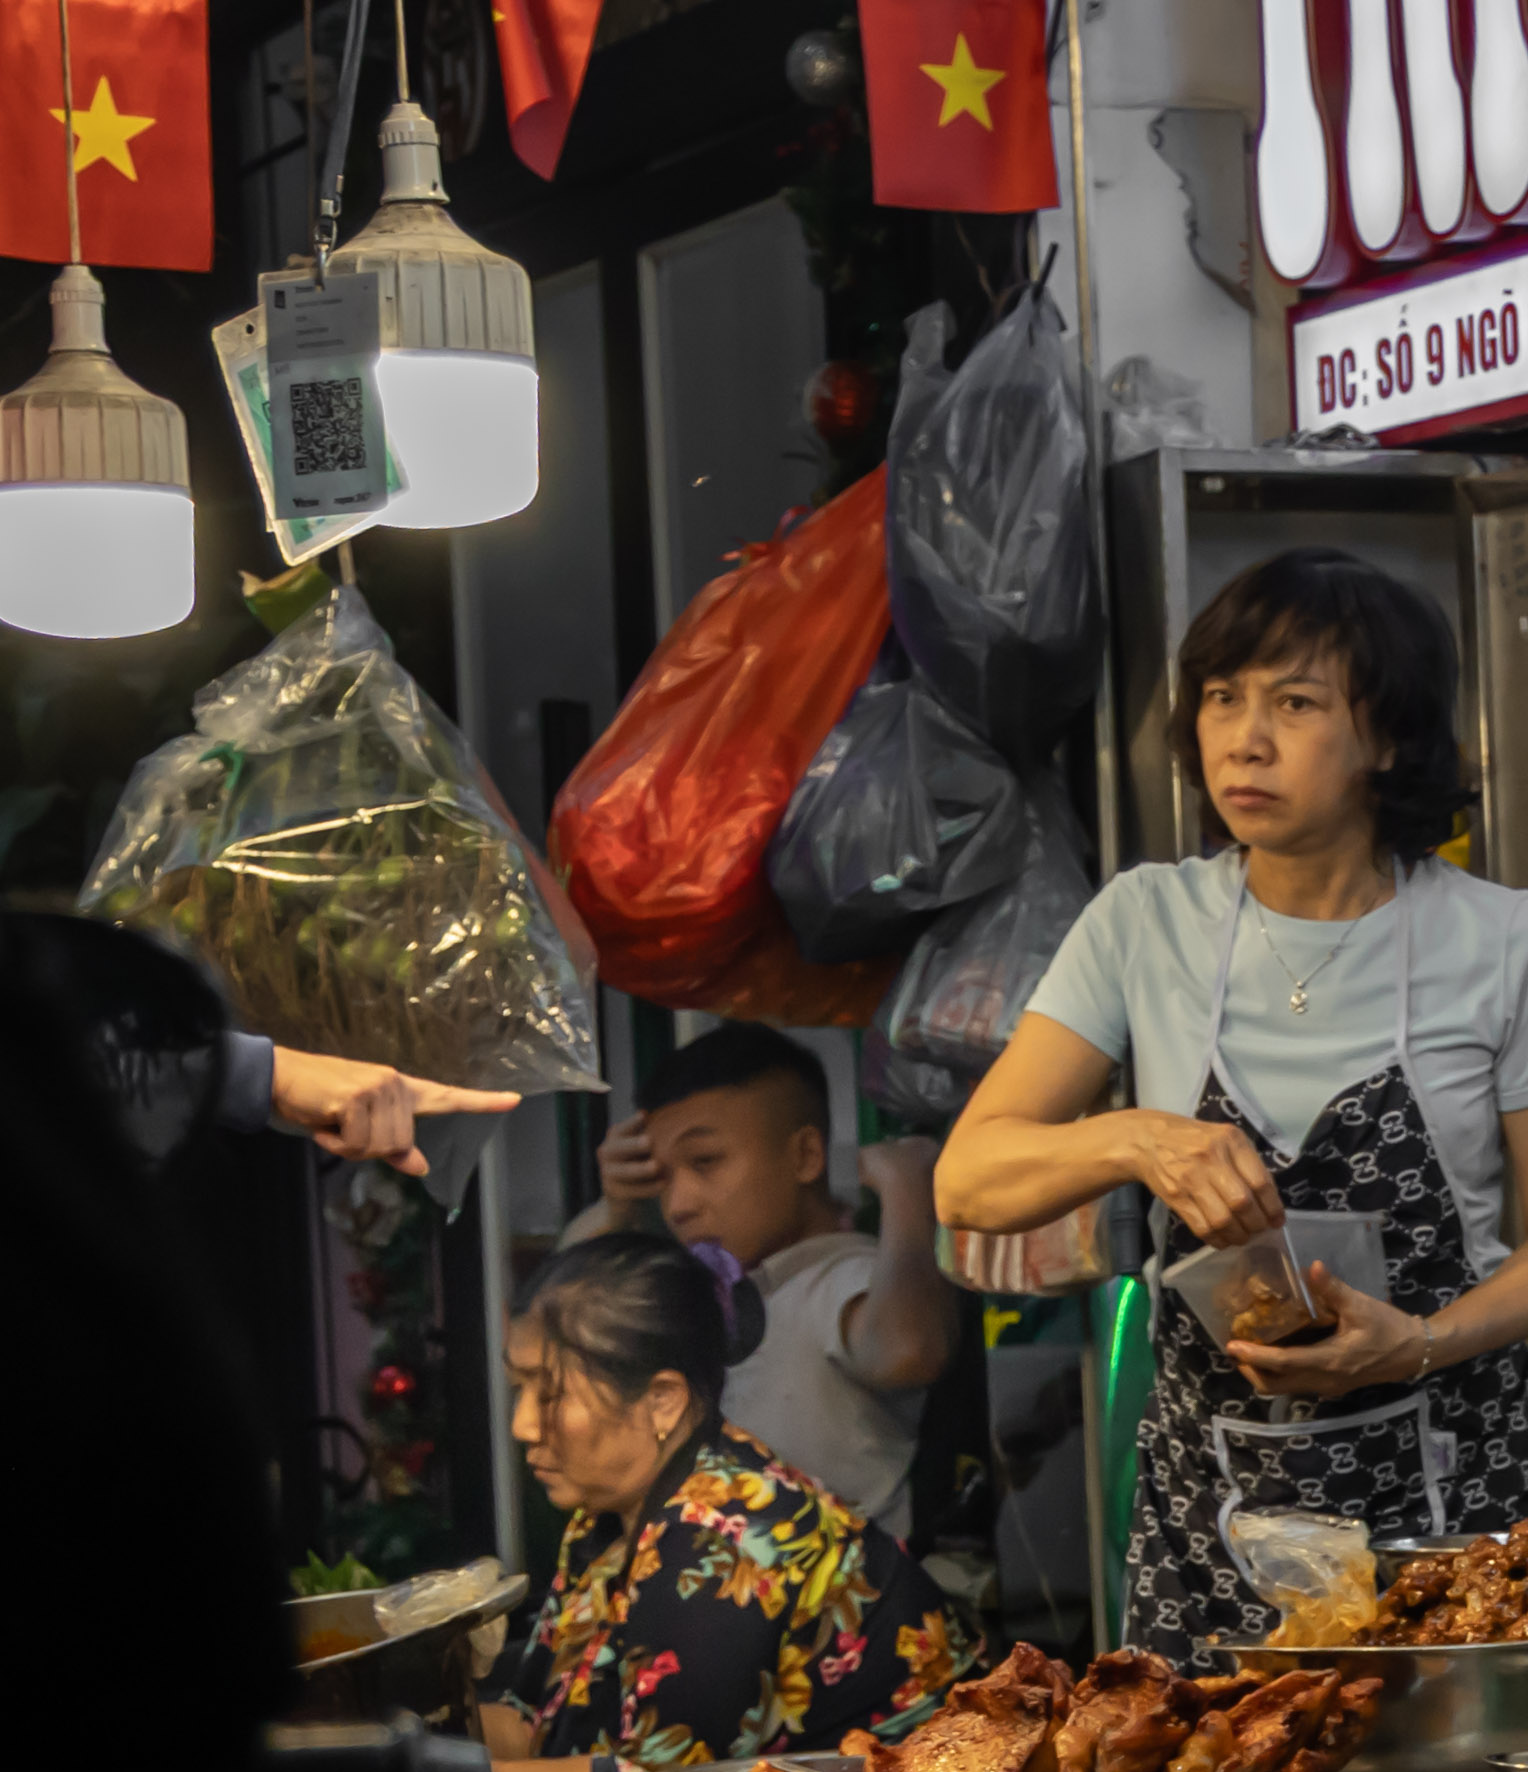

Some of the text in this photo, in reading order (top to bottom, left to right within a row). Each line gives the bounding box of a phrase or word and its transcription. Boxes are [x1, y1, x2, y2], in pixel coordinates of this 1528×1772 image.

[1317, 348, 1367, 414] ĐC:
[1376, 304, 1414, 399] SỐ
[1426, 324, 1444, 386] 9
